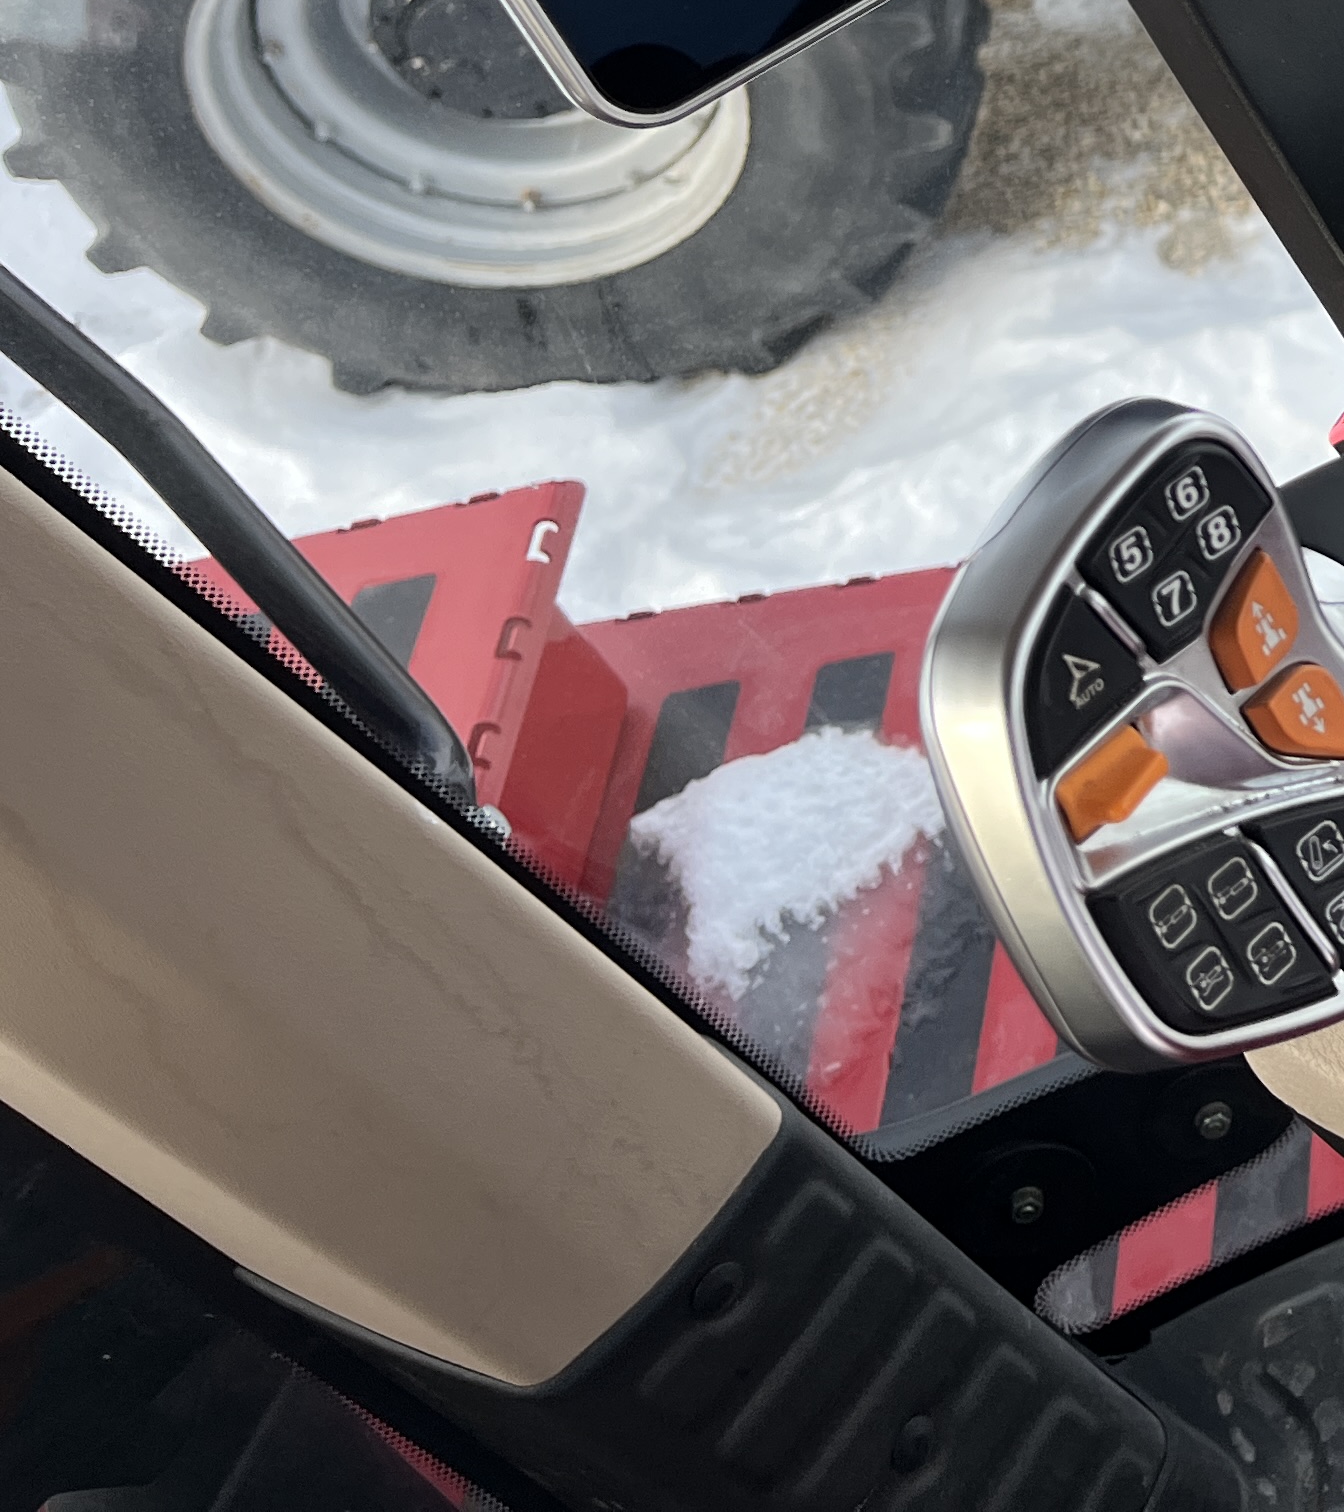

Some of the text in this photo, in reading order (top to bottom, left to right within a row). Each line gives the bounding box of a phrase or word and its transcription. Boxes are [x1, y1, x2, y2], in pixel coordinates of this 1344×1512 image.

[1176, 477, 1197, 507] 6
[1207, 518, 1231, 548] 8
[1119, 538, 1142, 571] 5
[1161, 579, 1180, 615] 7
[1073, 679, 1104, 708] AUTO
